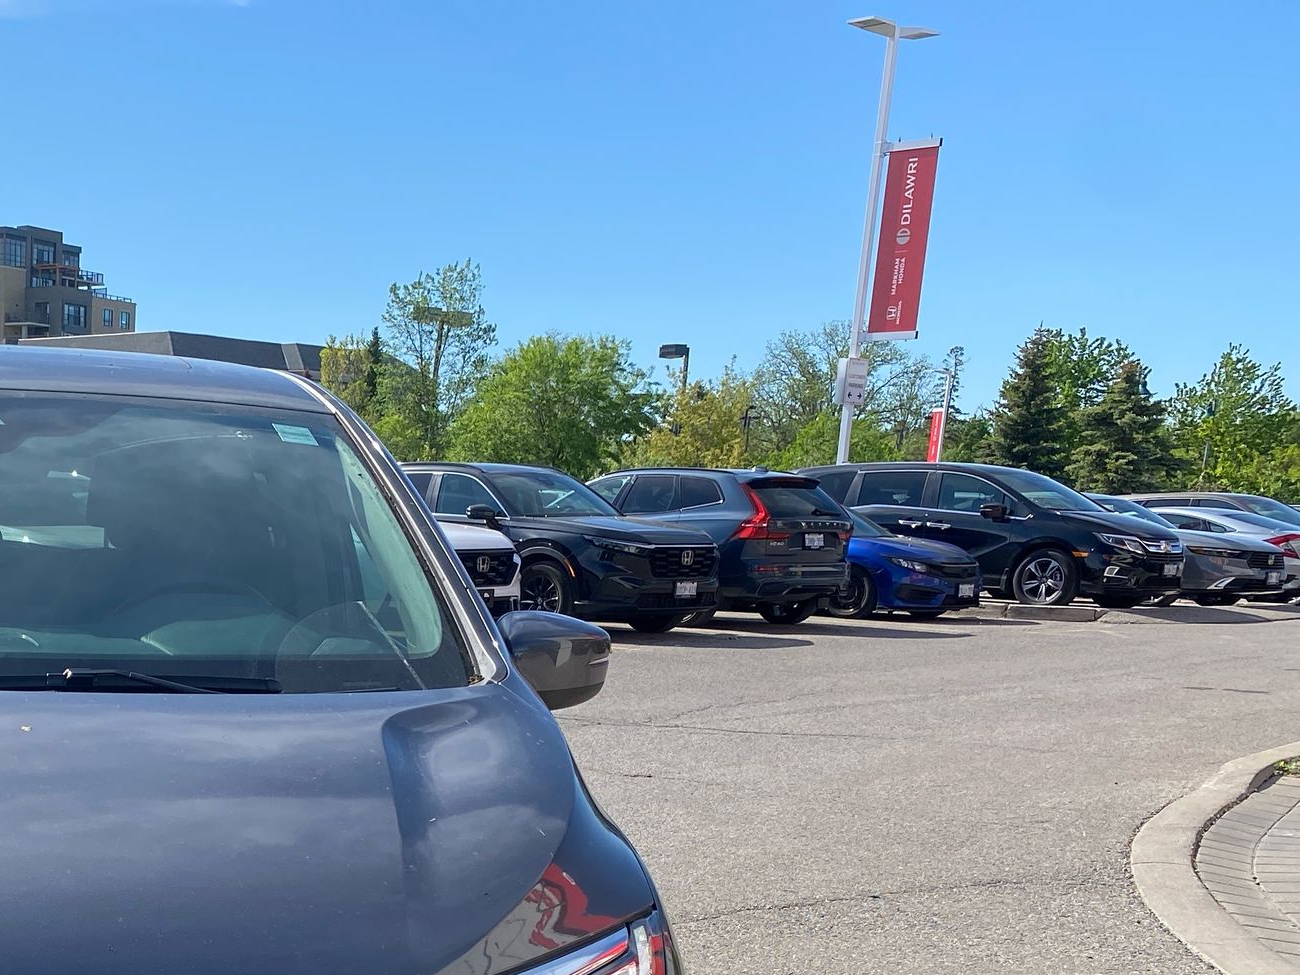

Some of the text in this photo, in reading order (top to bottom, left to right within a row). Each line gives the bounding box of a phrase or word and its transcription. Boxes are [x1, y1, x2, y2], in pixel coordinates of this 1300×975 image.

[900, 157, 919, 225] DILAWRI
[891, 257, 900, 296] MARKHAM
[897, 257, 906, 284] HONDA
